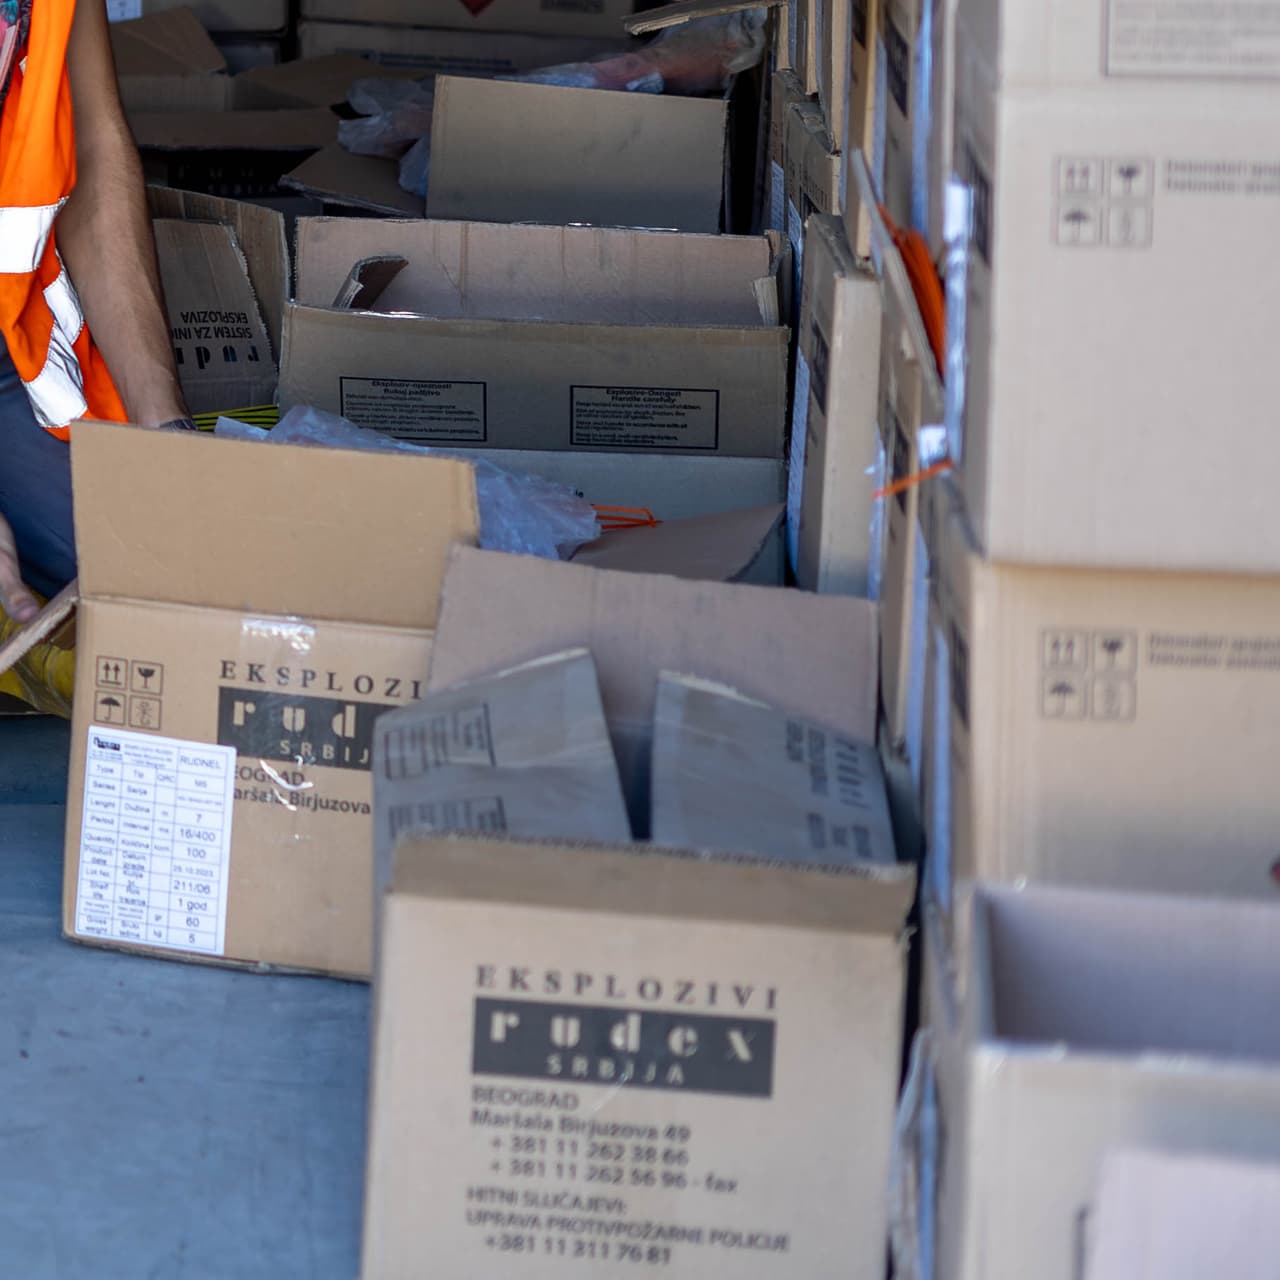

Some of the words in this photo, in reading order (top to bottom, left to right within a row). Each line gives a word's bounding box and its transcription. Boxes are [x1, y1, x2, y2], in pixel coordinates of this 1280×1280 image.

[180, 311, 248, 324] EKSPLOZIVA
[194, 327, 212, 339] ZA
[213, 326, 253, 339] SISTEM
[219, 659, 422, 700] EKSPLOZI
[233, 701, 357, 739] rud
[180, 755, 221, 769] RUDNEL
[290, 790, 371, 815] Birjuzova
[180, 828, 216, 841] 16/400
[187, 848, 206, 858] 100
[476, 965, 779, 1011] EKSPLOZIVI
[490, 1011, 755, 1062] rudex
[547, 1057, 685, 1085] SRBIJA
[471, 1086, 579, 1113] BEOGRAD
[511, 1136, 547, 1154] 381
[587, 1142, 625, 1162] 262
